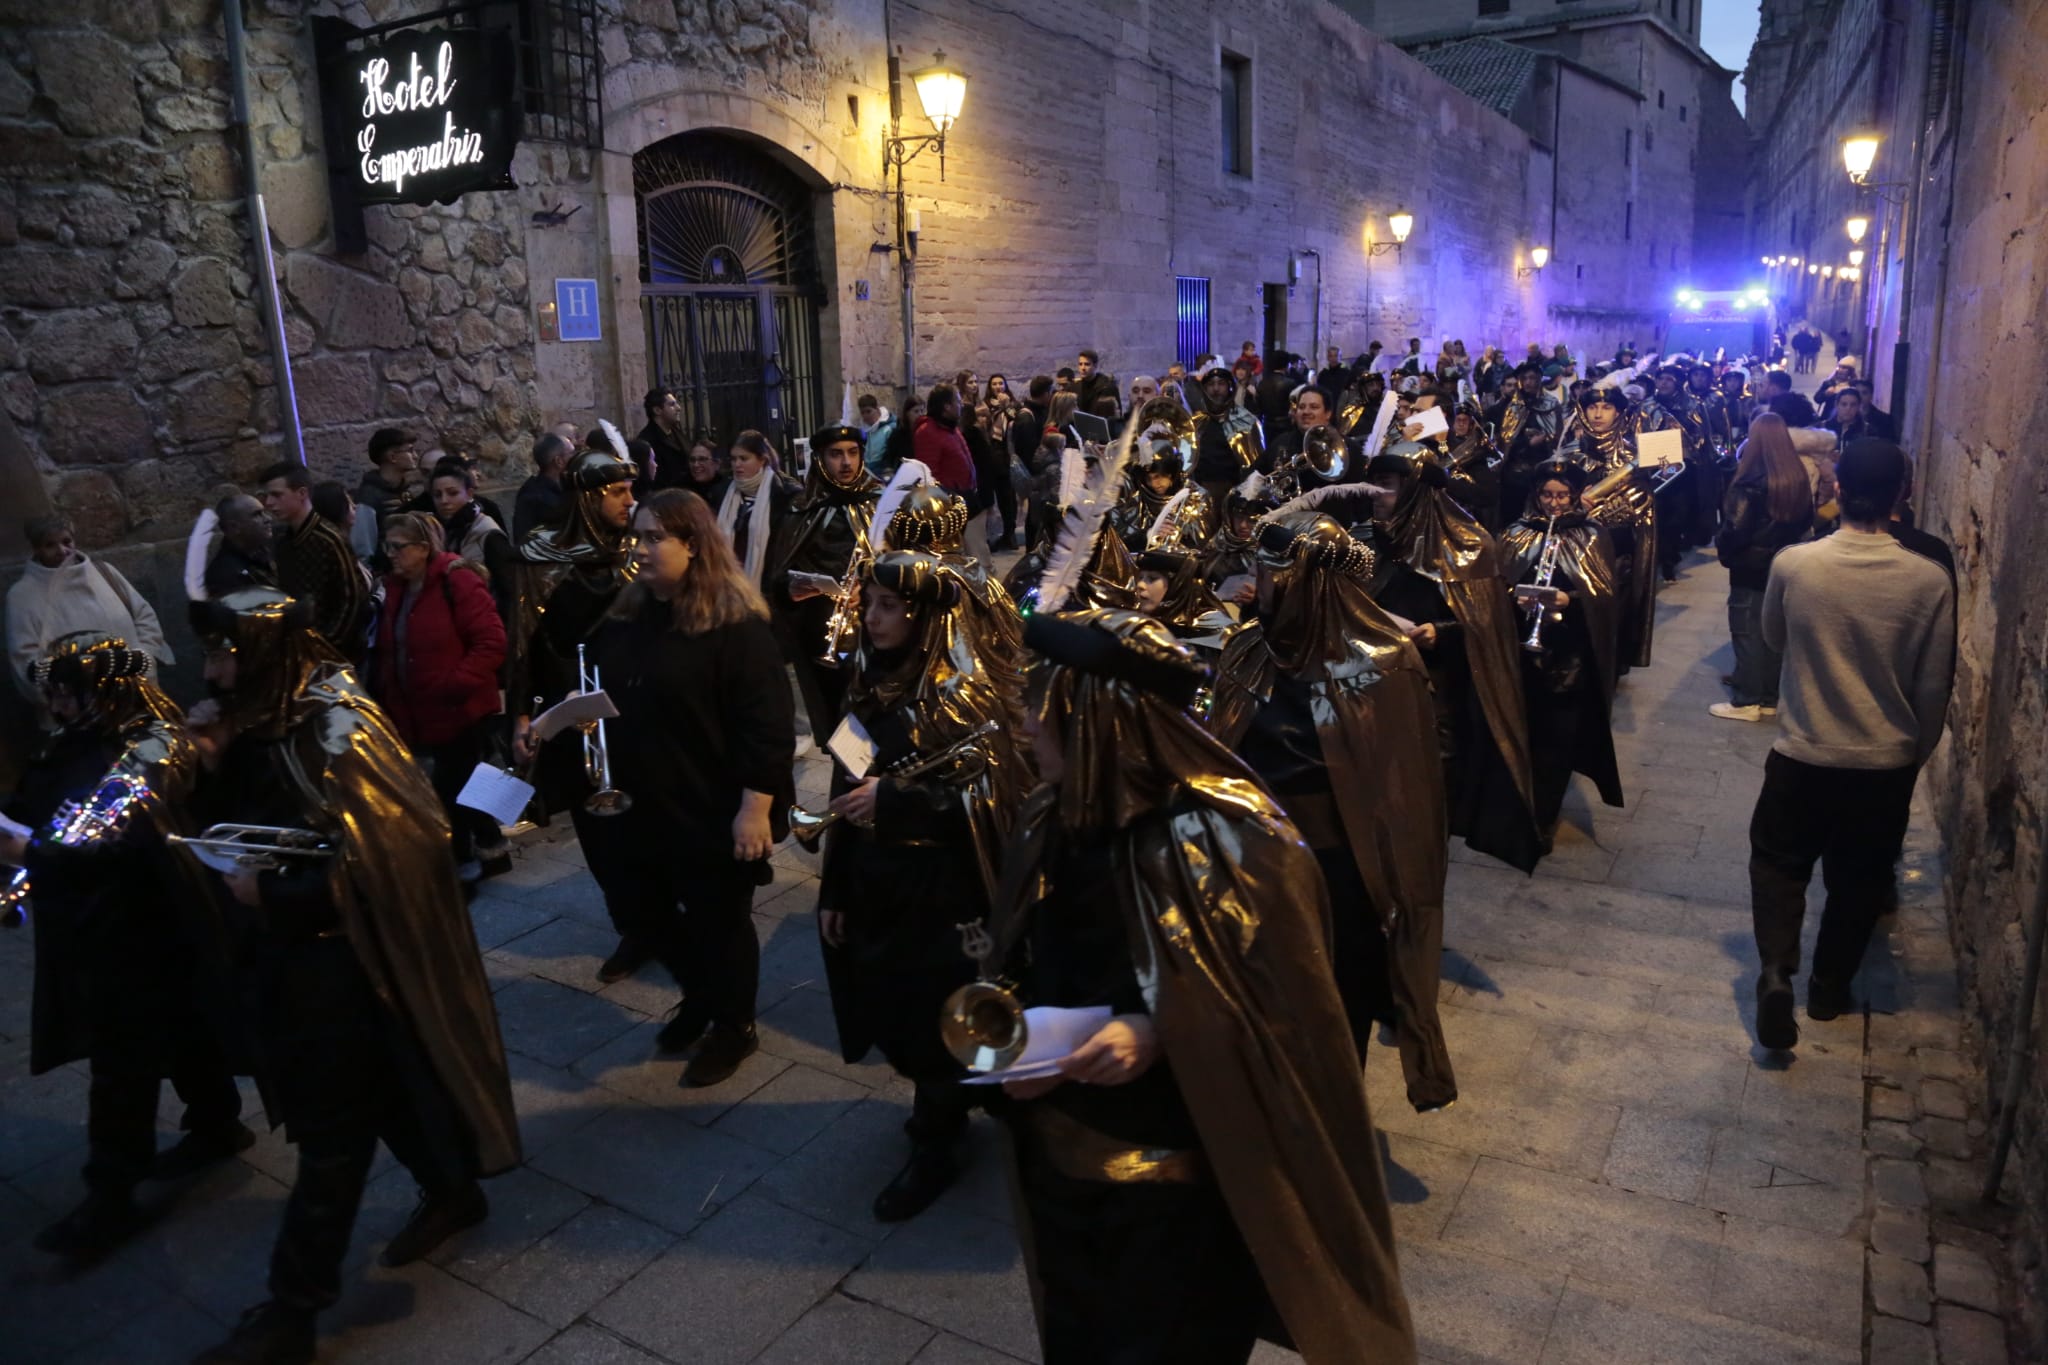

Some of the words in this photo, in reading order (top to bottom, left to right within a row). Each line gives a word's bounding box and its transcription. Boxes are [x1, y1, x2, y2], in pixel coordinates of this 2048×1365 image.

[360, 40, 457, 118] Hotel
[357, 110, 484, 194] Emperatriz
[567, 287, 590, 317] H
